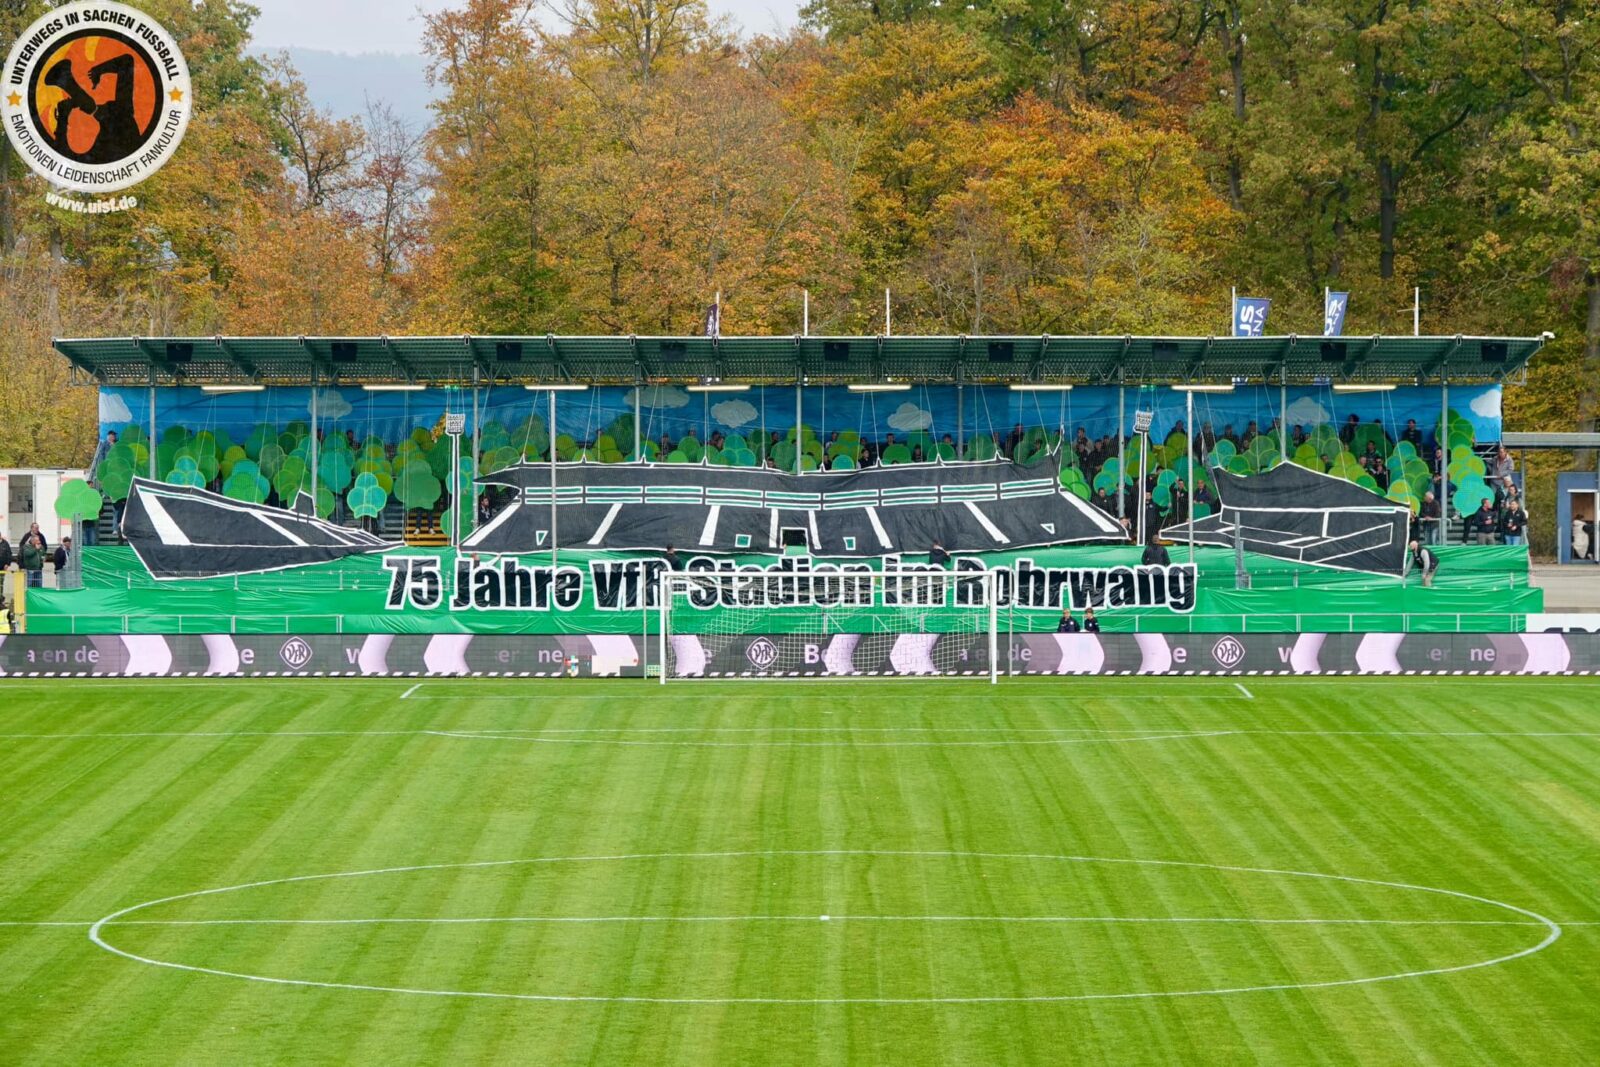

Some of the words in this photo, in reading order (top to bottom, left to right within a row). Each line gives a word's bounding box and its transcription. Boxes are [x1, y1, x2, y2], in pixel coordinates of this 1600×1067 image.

[383, 555, 443, 611] 75
[449, 556, 584, 611] Jahre
[882, 554, 946, 607] im
[954, 557, 1198, 614] Rohrwang
